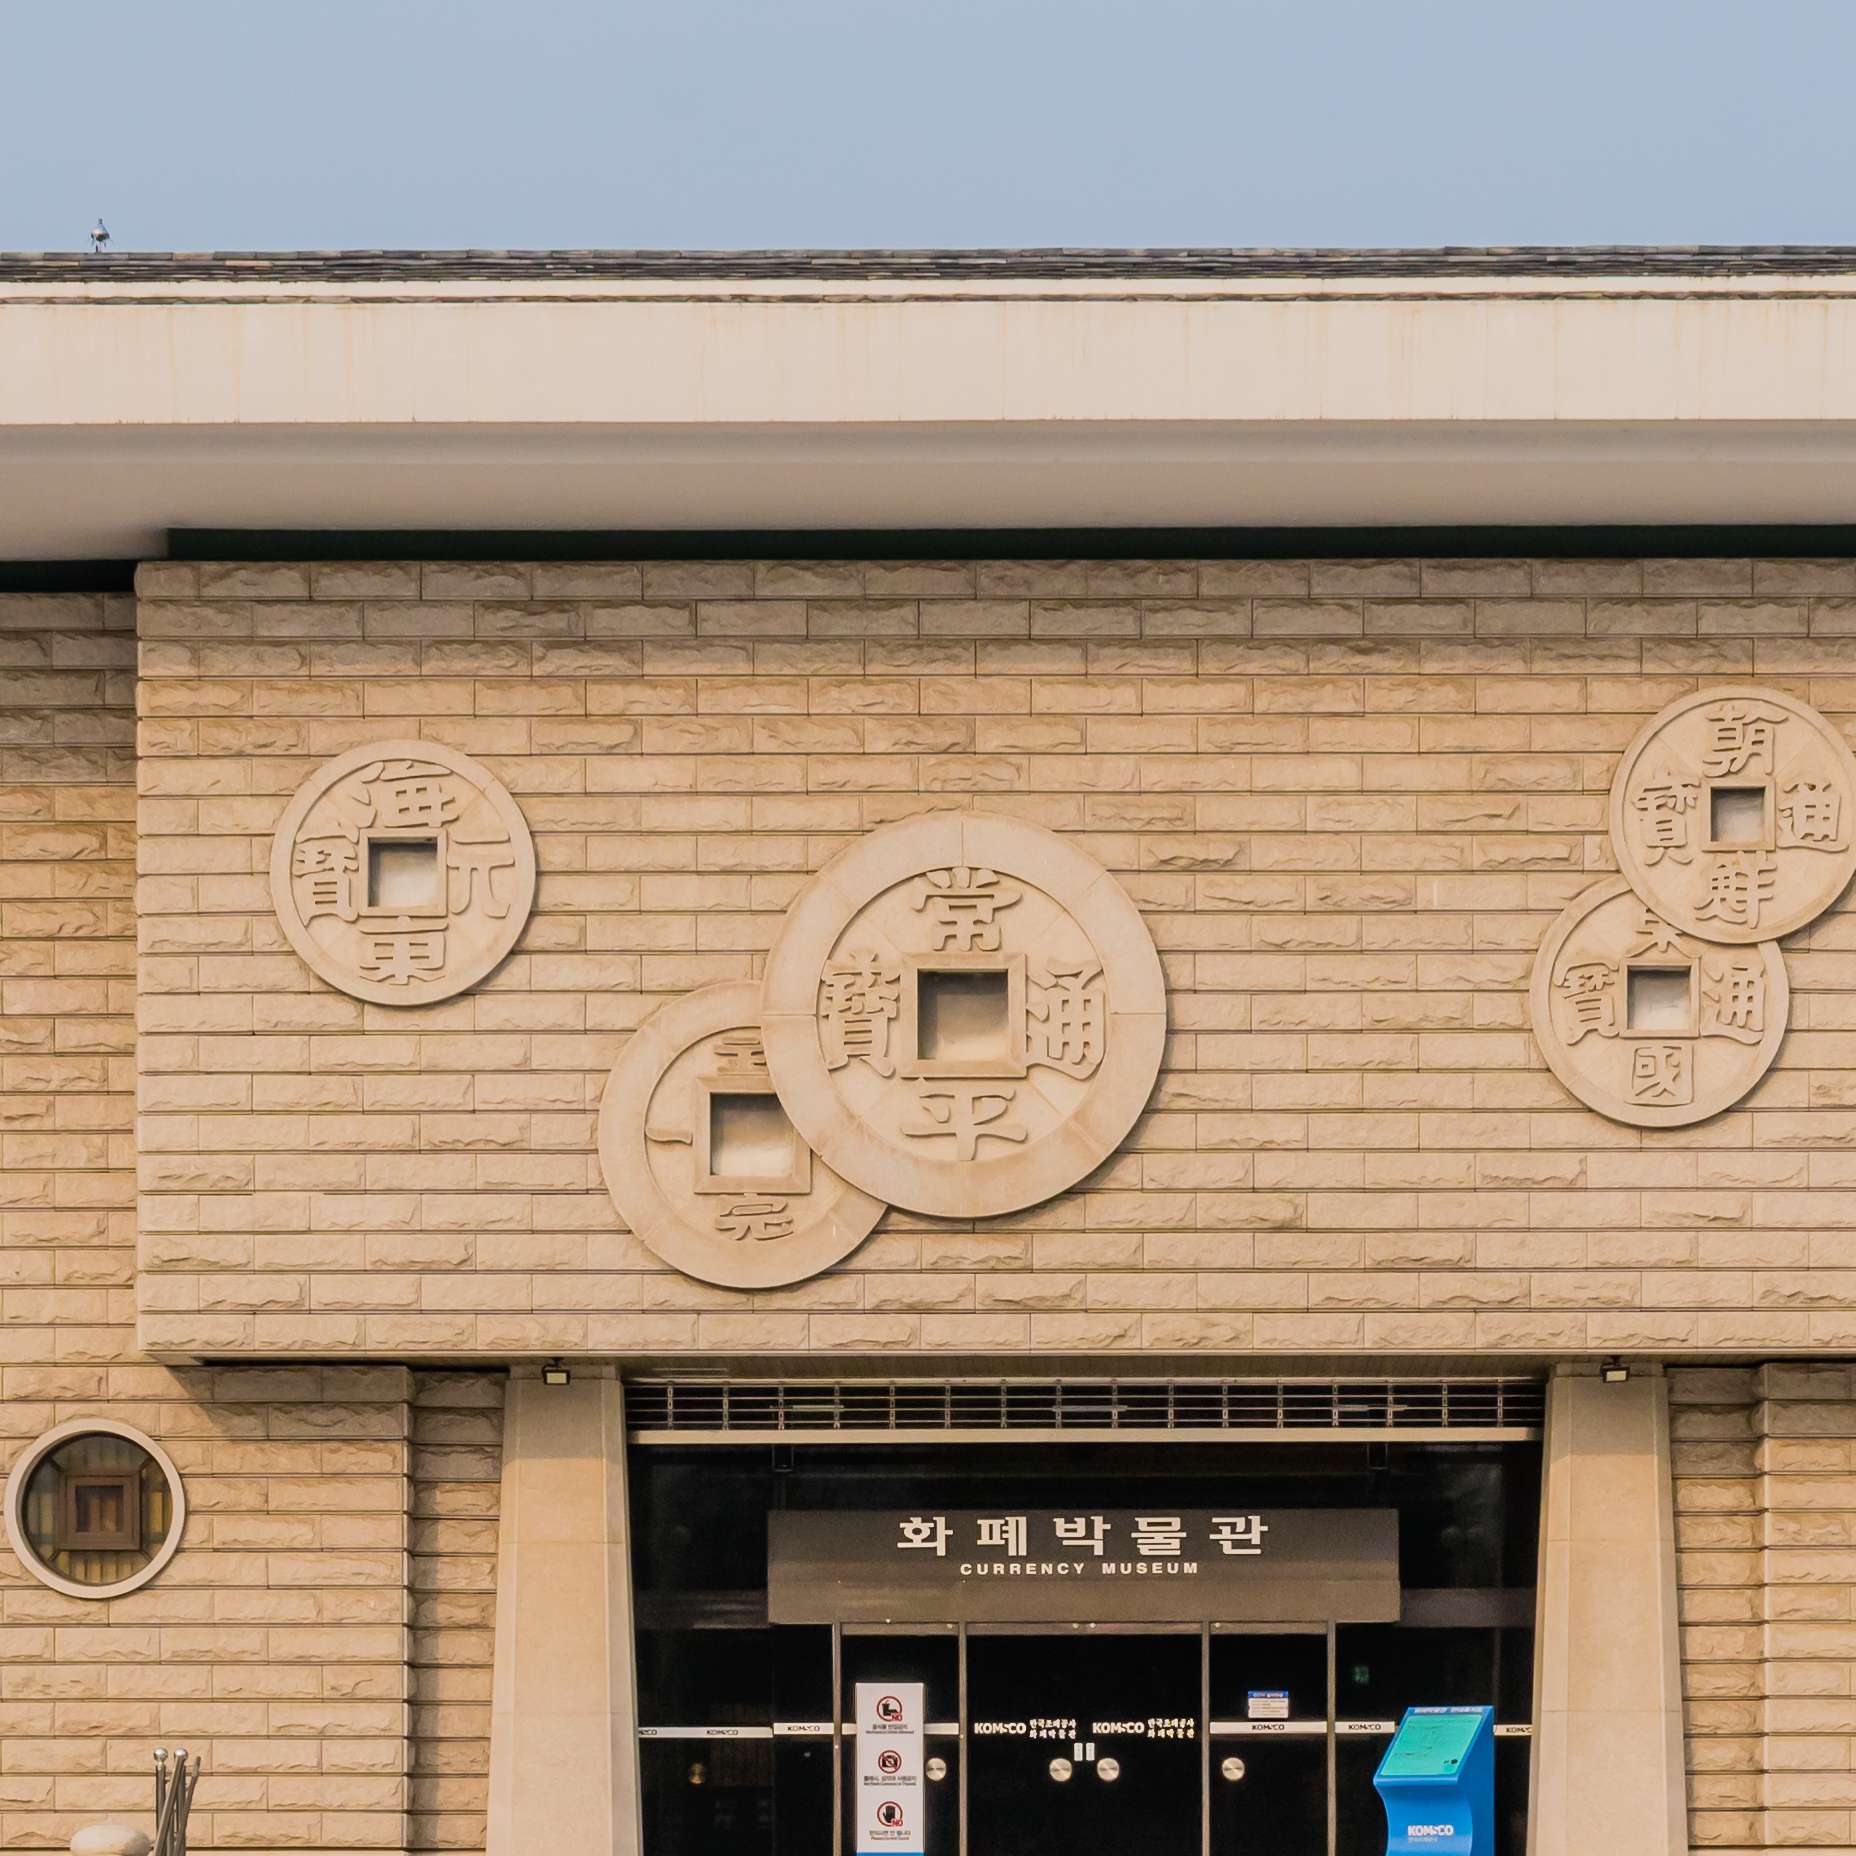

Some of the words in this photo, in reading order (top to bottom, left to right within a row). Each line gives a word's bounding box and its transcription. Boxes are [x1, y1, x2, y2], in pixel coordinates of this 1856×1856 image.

[896, 1515, 1269, 1557] 화폐박물관
[959, 1562, 1085, 1576] CURRENCY
[1102, 1561, 1199, 1575] MUSEUM
